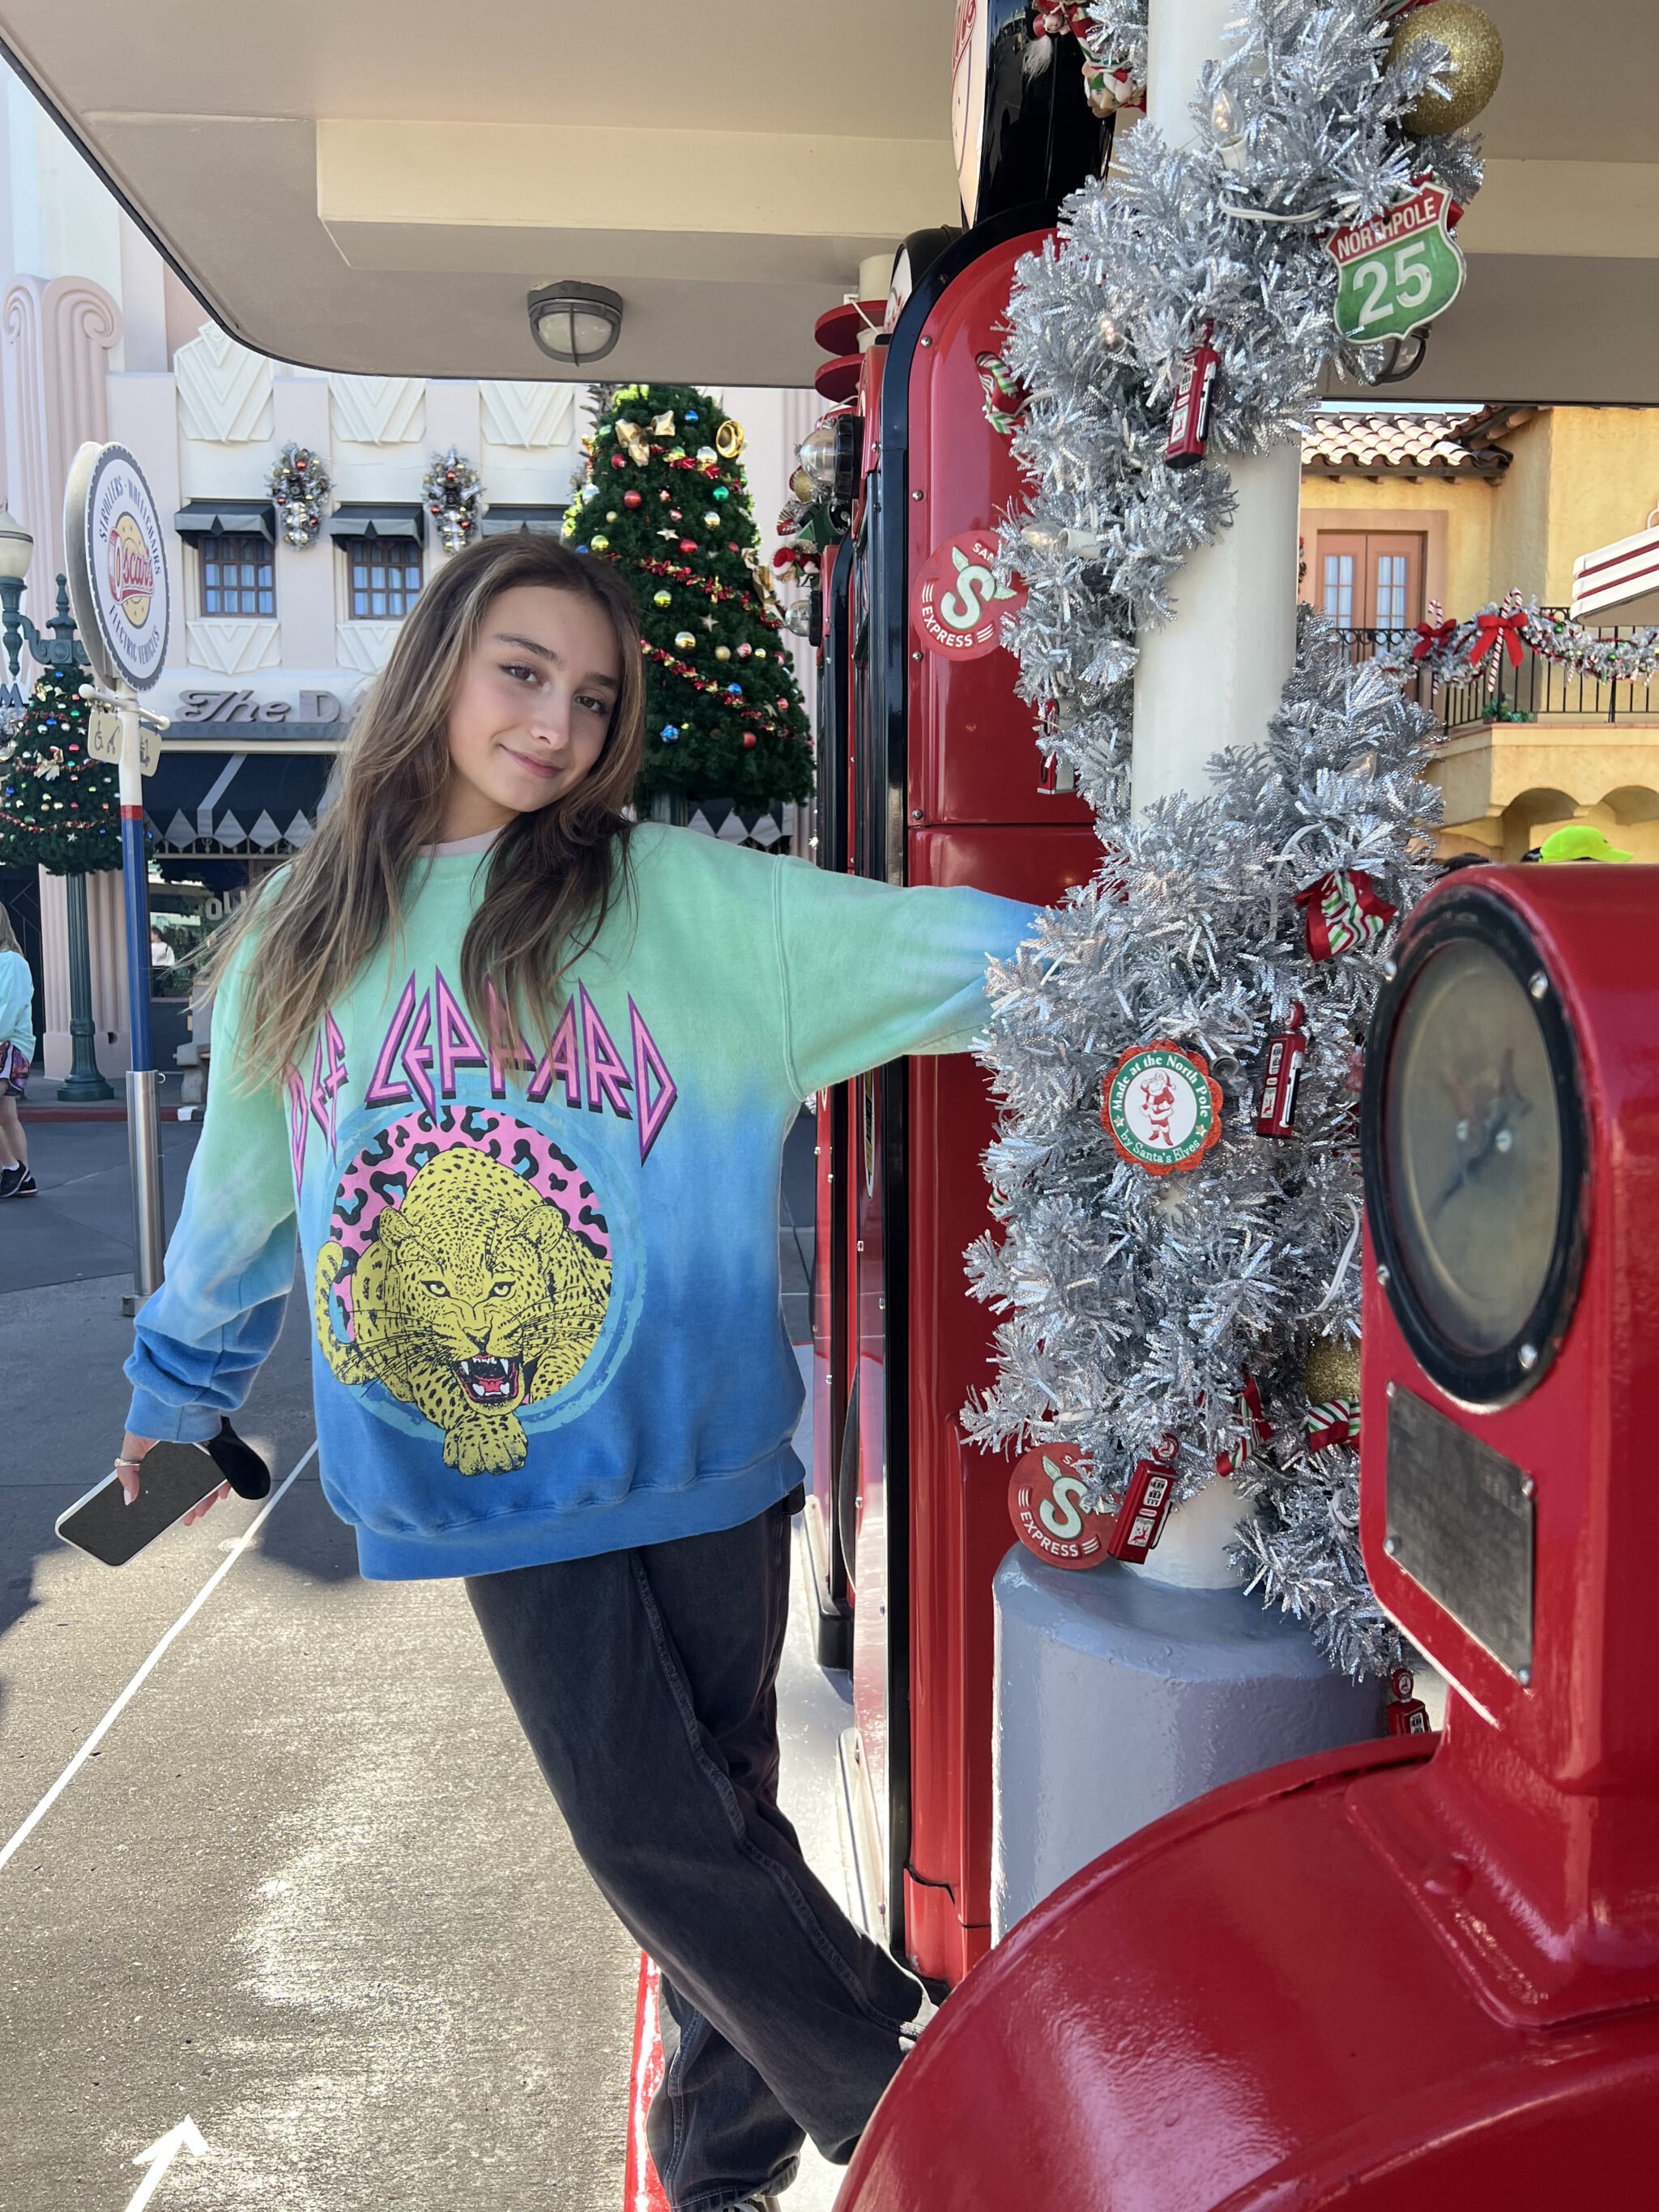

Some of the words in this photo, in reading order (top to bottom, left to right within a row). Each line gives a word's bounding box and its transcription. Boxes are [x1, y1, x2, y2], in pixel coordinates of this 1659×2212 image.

[1352, 241, 1433, 326] 25
[99, 475, 124, 543] STROLLERS
[110, 535, 154, 596] Oscar's
[109, 604, 137, 662] ELECTRIC
[138, 624, 160, 664] VEHICLES
[922, 606, 973, 648] EXPRESS
[175, 689, 291, 722] The
[284, 1001, 349, 1210] DEF
[364, 964, 678, 1167] LEPPARD
[1112, 1076, 1131, 1111] Made
[1129, 1062, 1141, 1076] at
[1143, 1055, 1163, 1067] the
[1166, 1055, 1199, 1085] North
[1196, 1085, 1211, 1118] Pole
[1120, 1128, 1133, 1147] by
[1132, 1142, 1172, 1163] Santa's
[1172, 1140, 1201, 1161] Elves
[1020, 1511, 1079, 1558] EXPRESS
